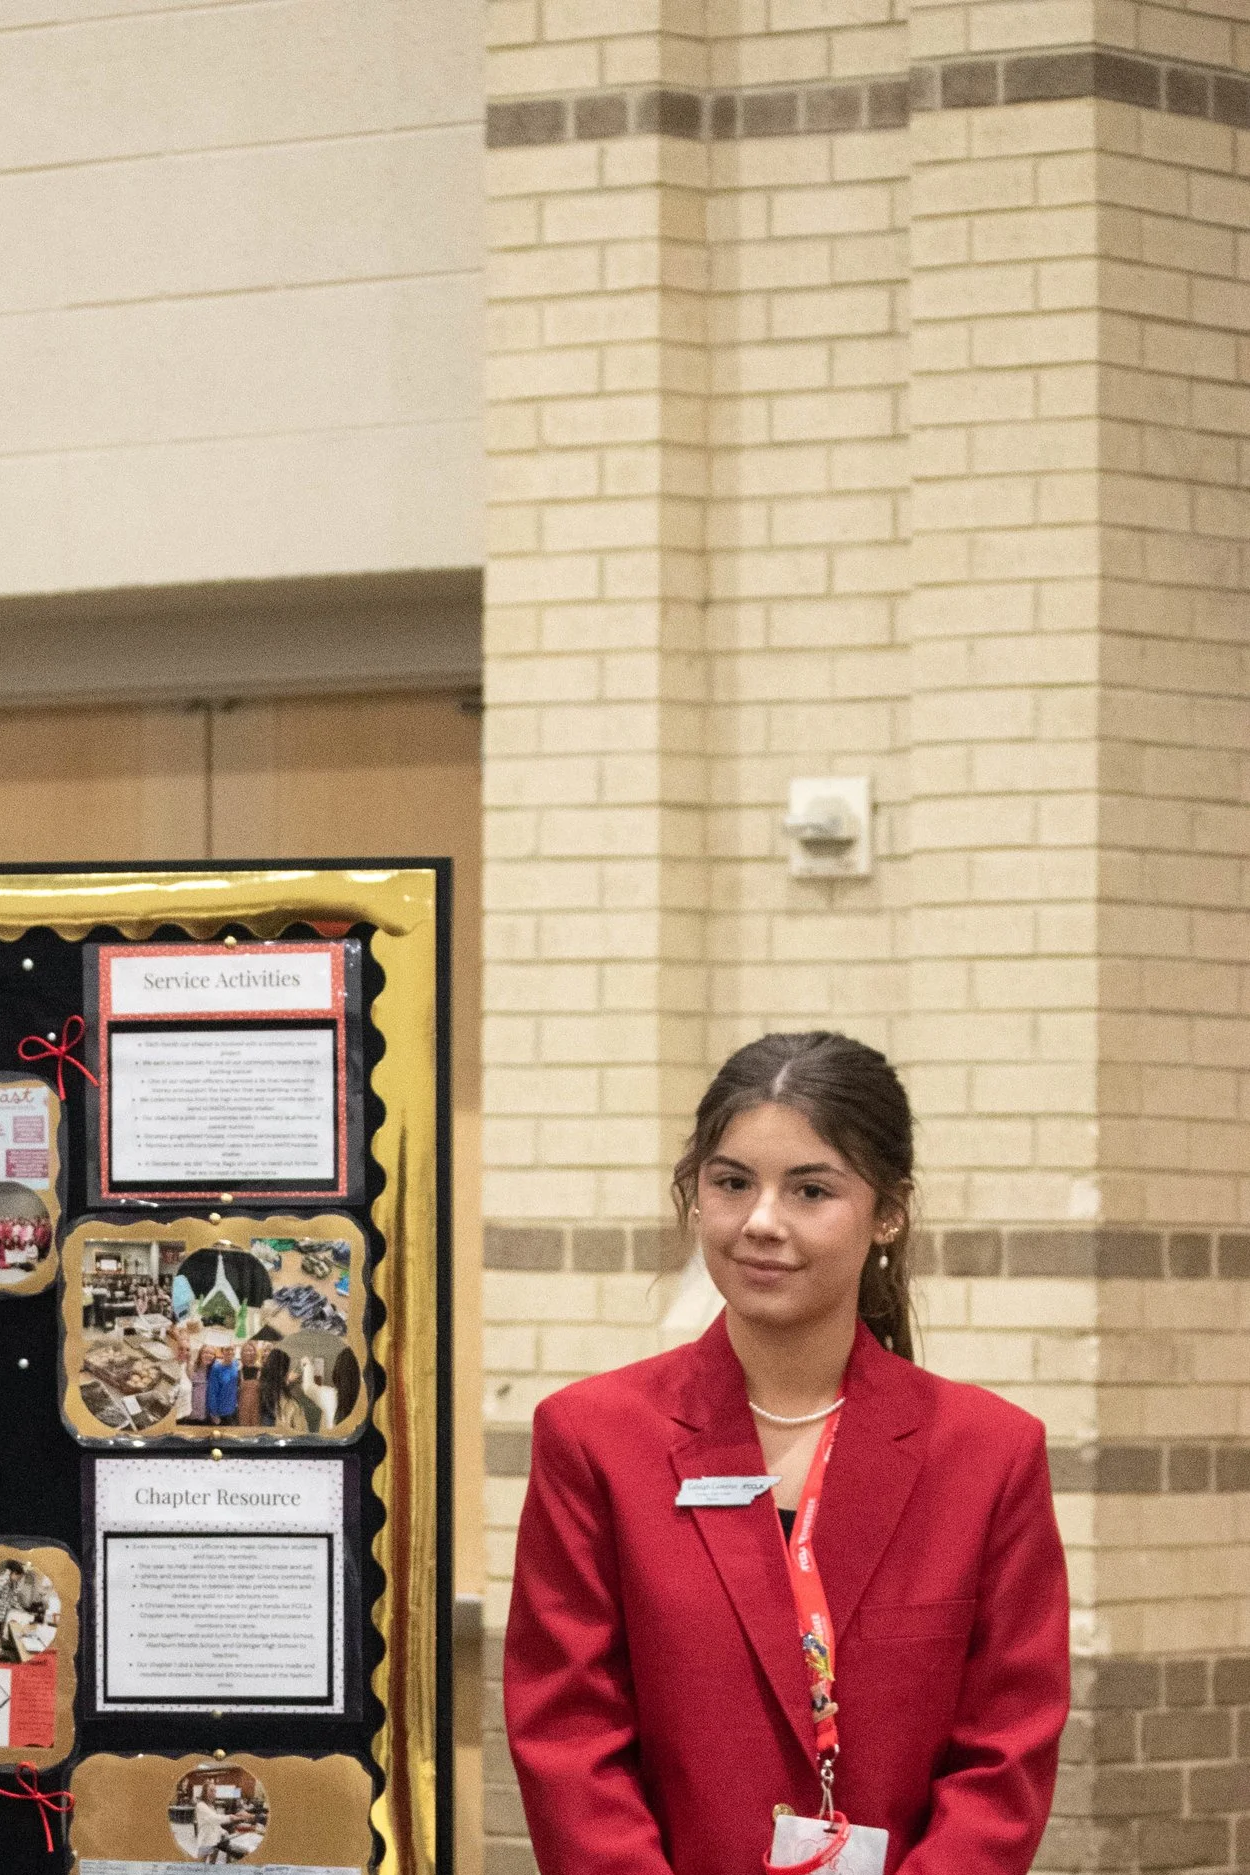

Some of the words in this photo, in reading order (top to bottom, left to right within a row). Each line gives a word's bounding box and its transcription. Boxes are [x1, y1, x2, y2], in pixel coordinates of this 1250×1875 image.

[143, 971, 209, 990] Service
[215, 969, 300, 988] Activities
[135, 1487, 211, 1508] Chapter
[217, 1489, 301, 1506] Resource
